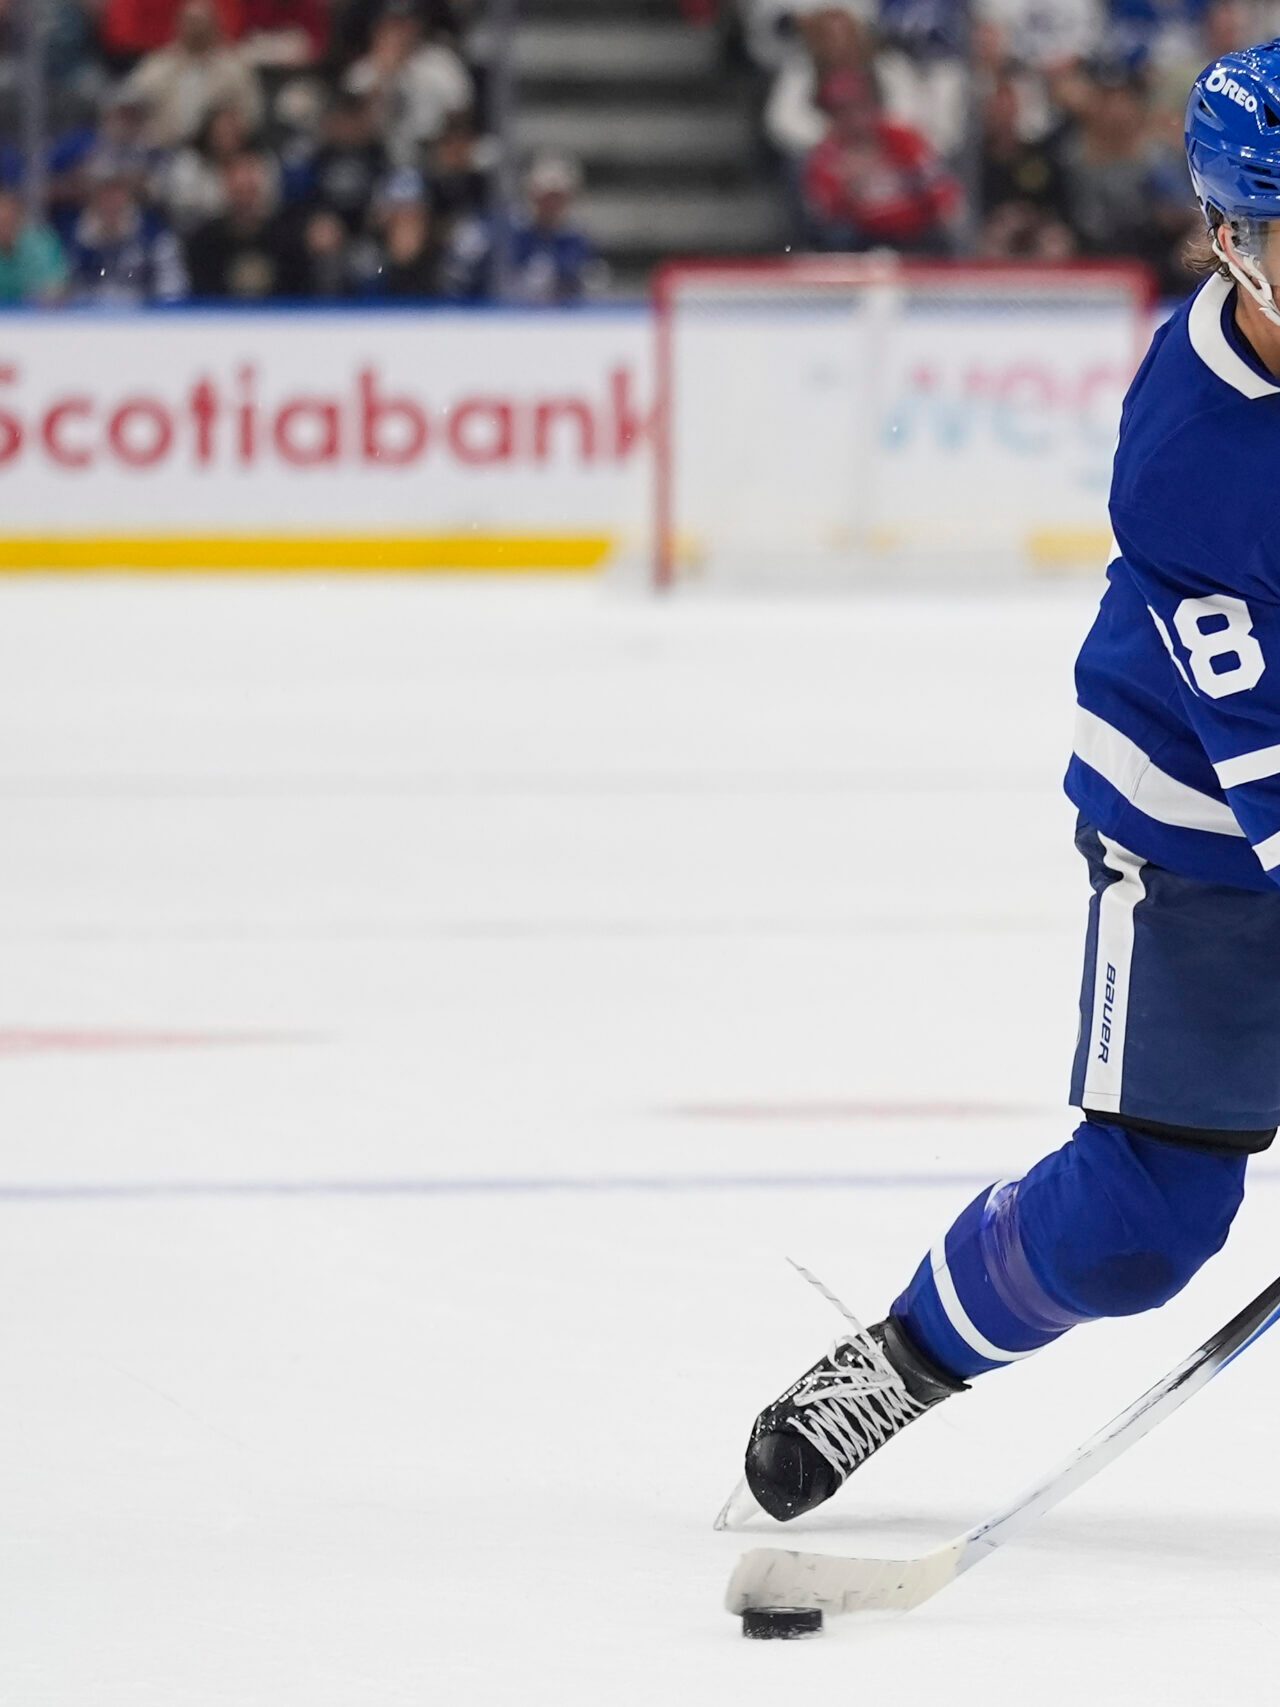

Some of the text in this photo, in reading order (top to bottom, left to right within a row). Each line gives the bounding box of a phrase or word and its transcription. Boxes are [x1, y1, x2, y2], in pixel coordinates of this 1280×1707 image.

[1205, 70, 1257, 112] OREO
[1147, 594, 1266, 699] 8
[1098, 962, 1116, 1064] BAUER
